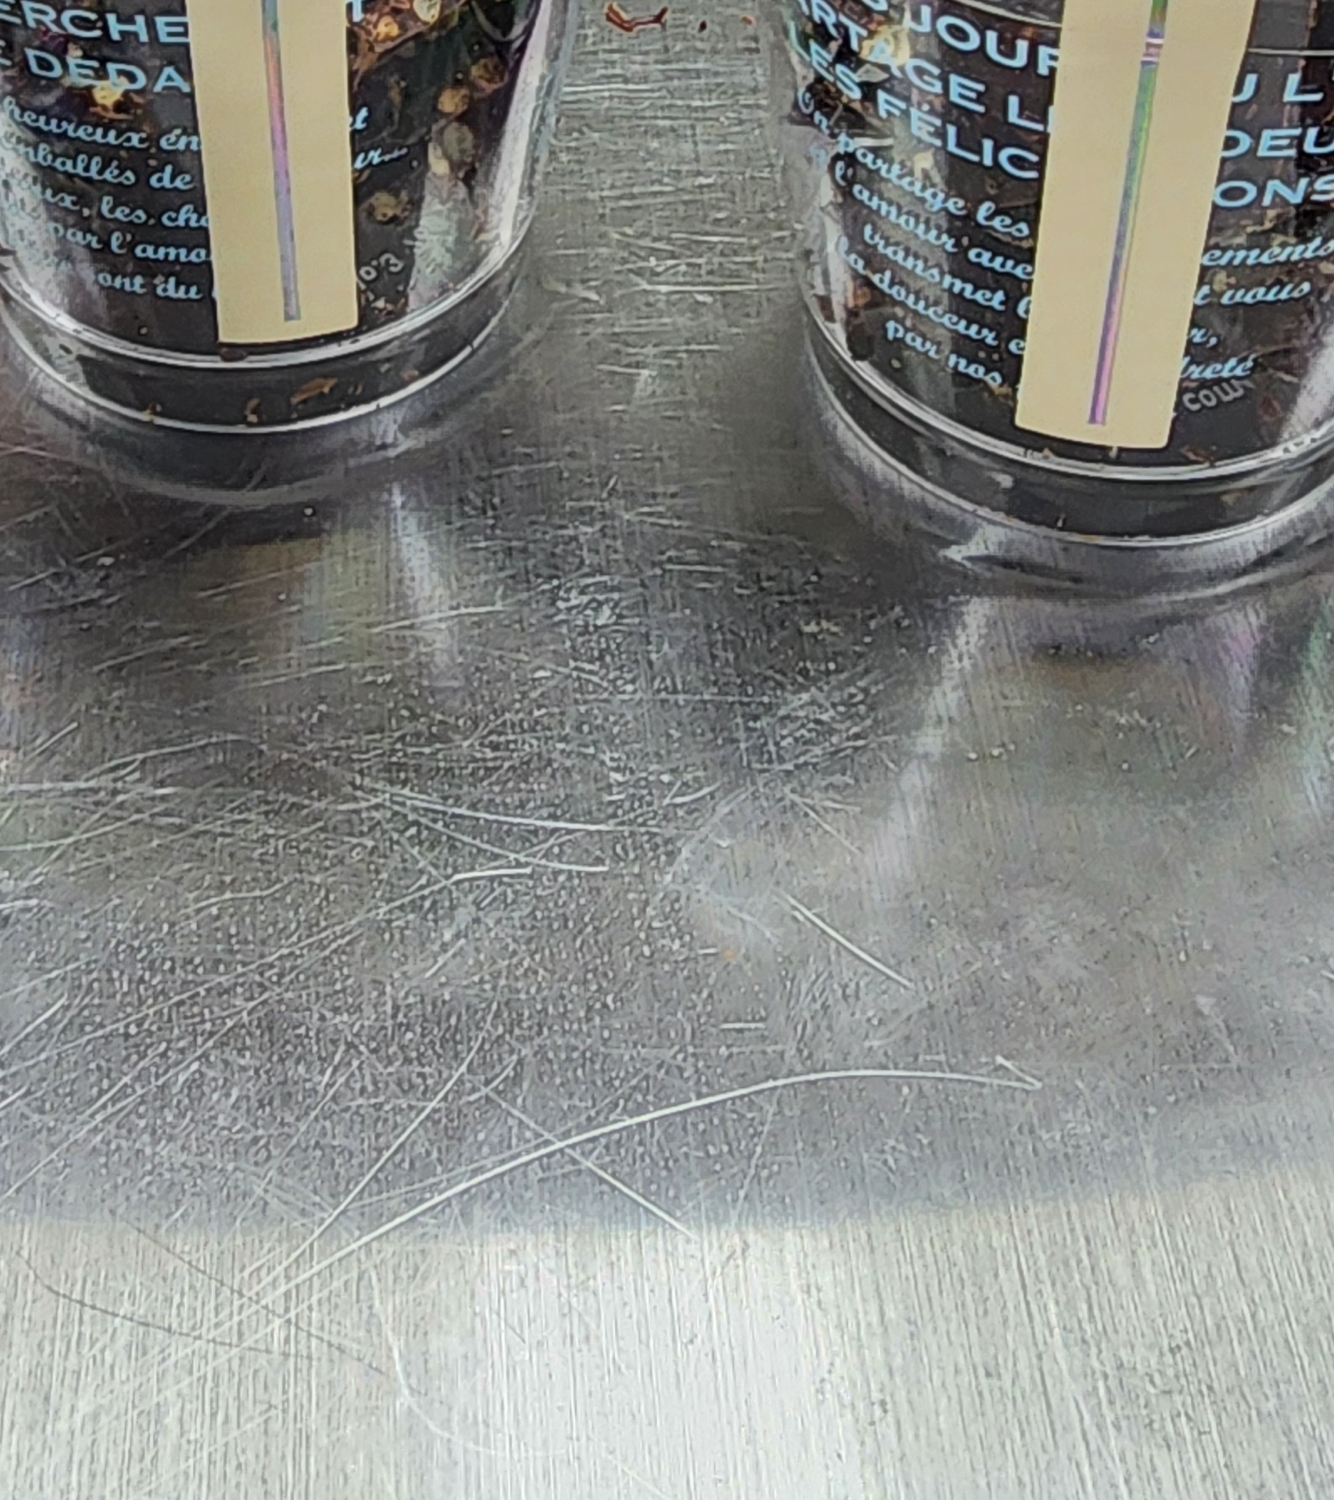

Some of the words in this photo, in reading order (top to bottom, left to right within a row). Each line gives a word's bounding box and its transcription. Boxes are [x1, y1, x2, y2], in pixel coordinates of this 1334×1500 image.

[788, 19, 863, 101] LES
[1007, 94, 1053, 134] L
[101, 195, 148, 224] les
[149, 164, 194, 190] de
[836, 131, 968, 216] partage
[976, 201, 1031, 238] les
[156, 275, 203, 300] du
[863, 223, 1007, 311] transmet
[872, 269, 999, 347] douceur
[885, 319, 941, 359] par
[947, 352, 1004, 387] nos
